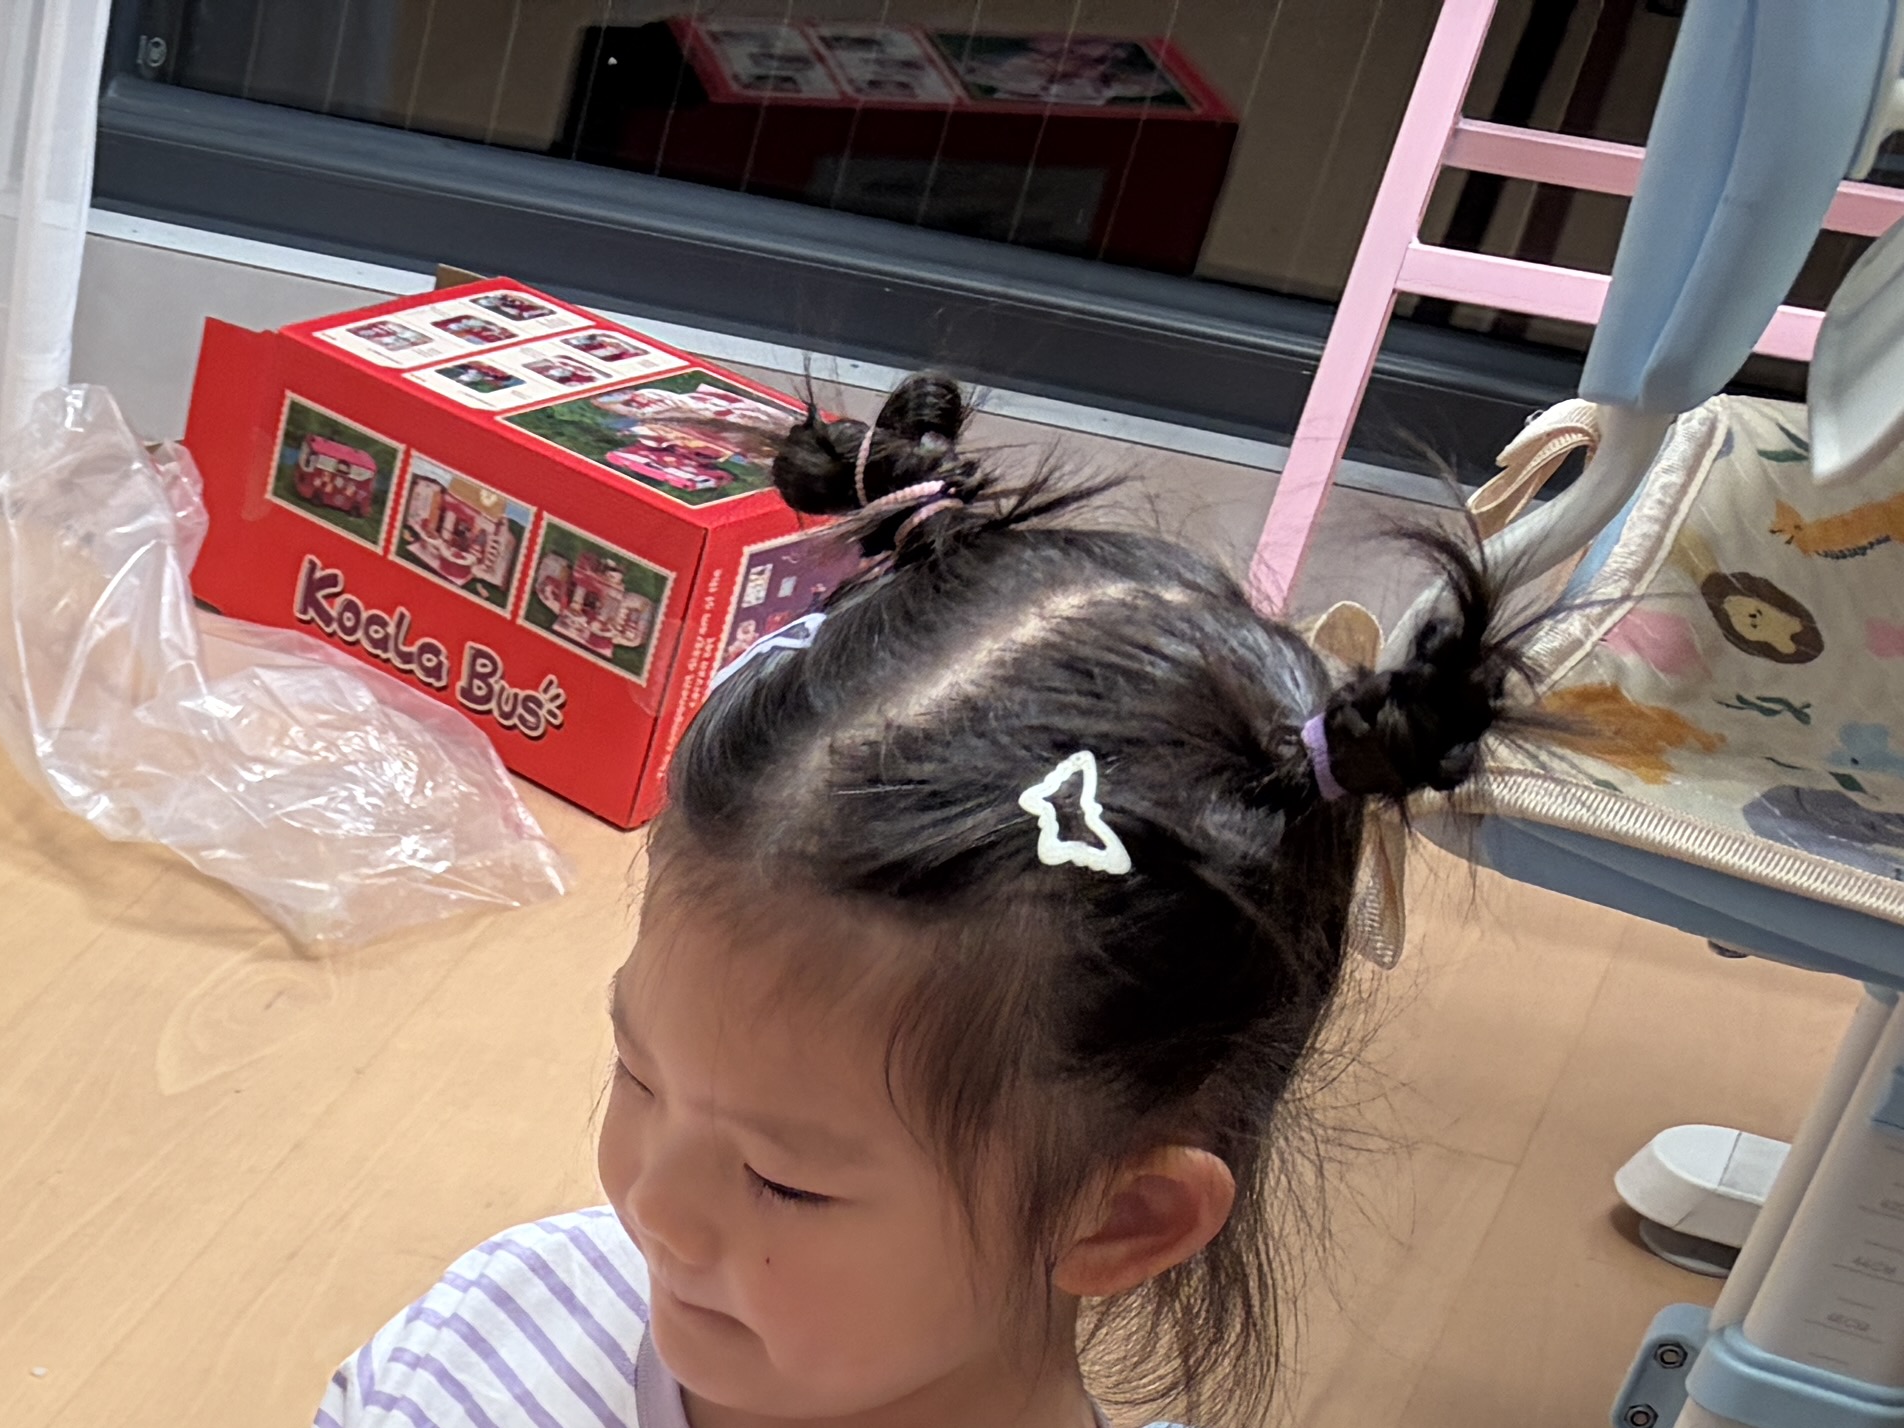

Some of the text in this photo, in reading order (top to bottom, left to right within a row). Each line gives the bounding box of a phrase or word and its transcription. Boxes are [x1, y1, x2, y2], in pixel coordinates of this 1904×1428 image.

[708, 568, 724, 594] the
[294, 554, 546, 738] Koala Bus
